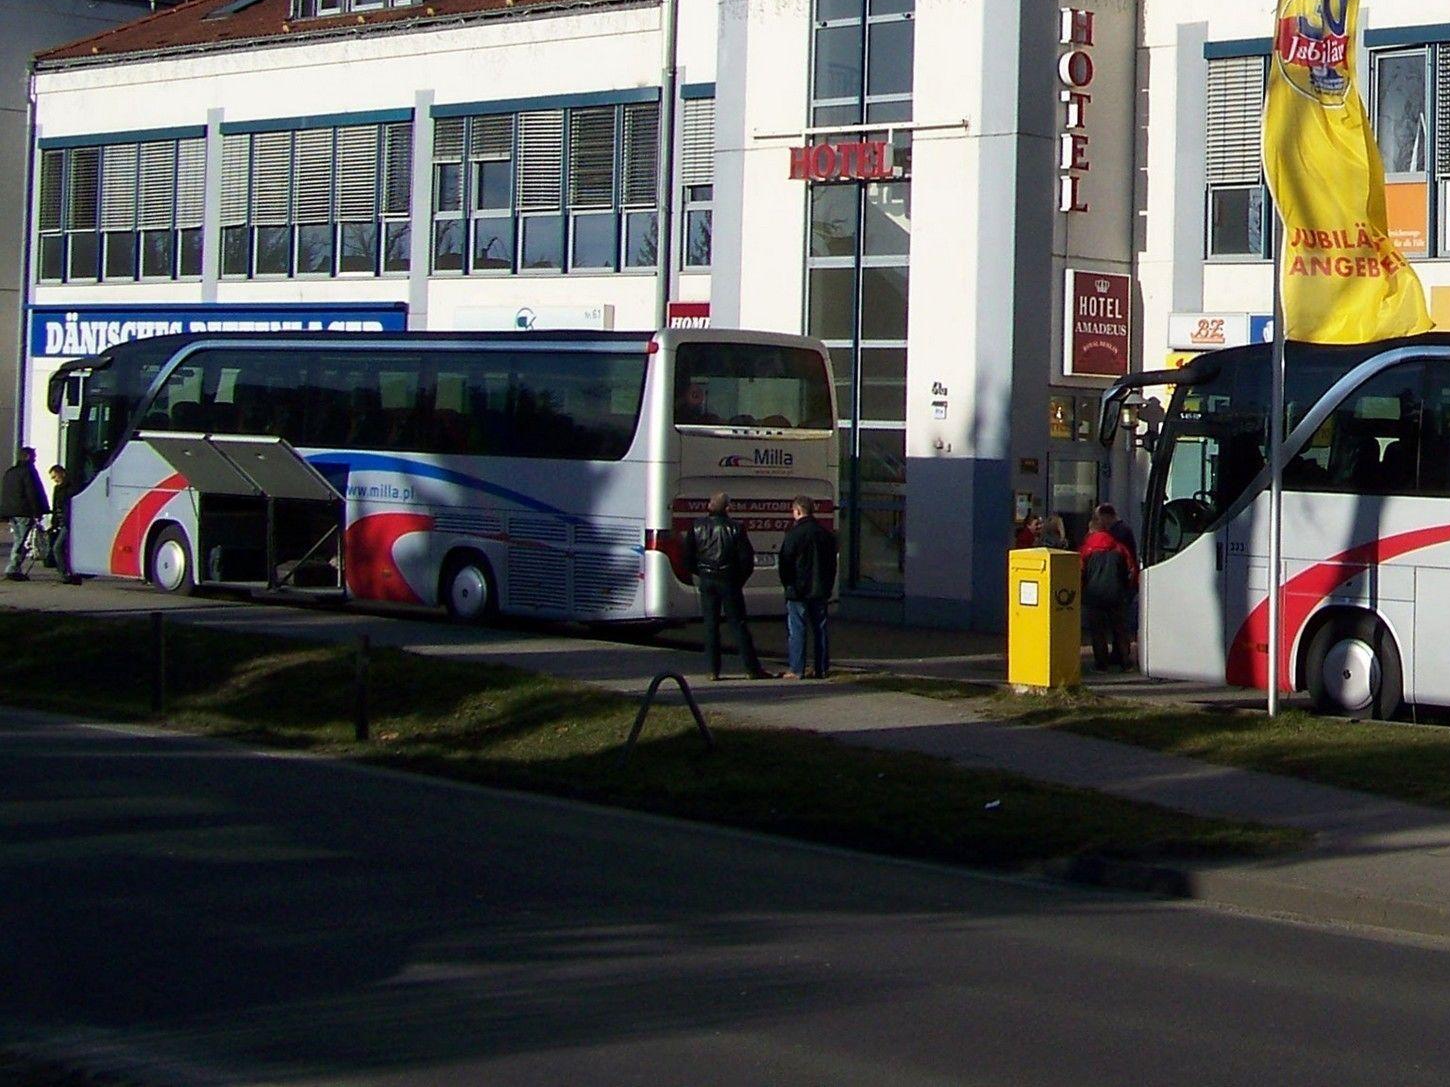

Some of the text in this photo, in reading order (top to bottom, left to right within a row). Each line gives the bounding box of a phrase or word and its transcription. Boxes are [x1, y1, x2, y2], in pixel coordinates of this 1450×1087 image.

[1059, 7, 1095, 213] HOTEL
[788, 141, 893, 180] HOTEL
[1080, 296, 1122, 319] HOTEL
[1075, 321, 1127, 336] AMADEUS
[754, 448, 794, 466] Milla
[348, 484, 414, 501] ww.milla.pl
